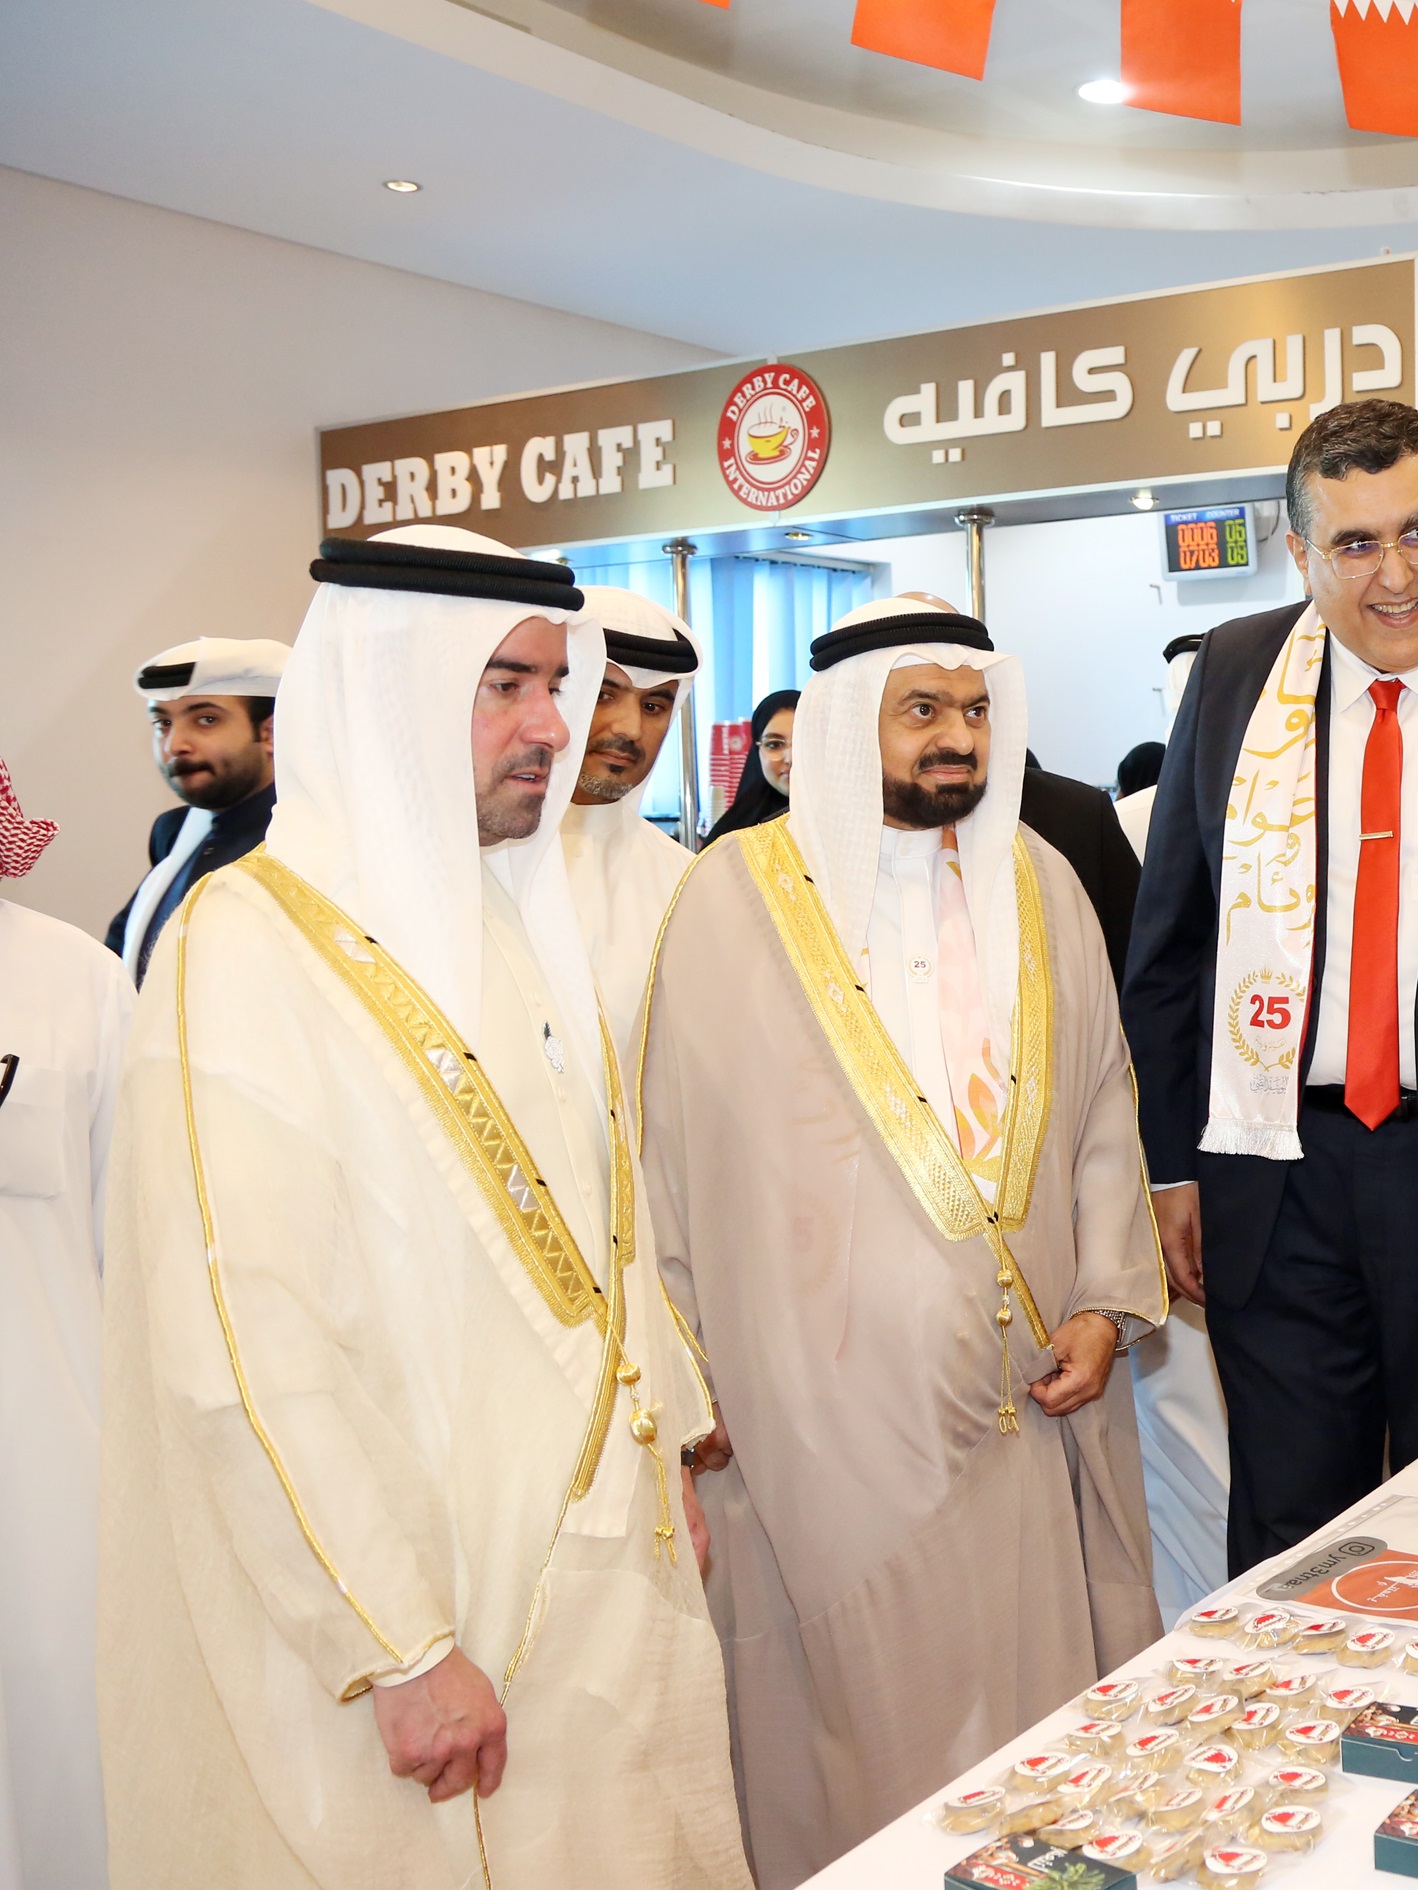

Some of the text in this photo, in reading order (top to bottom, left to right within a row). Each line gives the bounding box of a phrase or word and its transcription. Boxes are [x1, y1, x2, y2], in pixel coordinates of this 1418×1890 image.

[726, 372, 816, 422] DERBY CAFE
[883, 323, 1403, 465] دربي كافيه
[325, 419, 675, 530] DERBY CAFE
[723, 448, 821, 507] INTERNATIONAL
[1170, 508, 1240, 521] TICKET COUNTER
[1177, 519, 1246, 546] 0006 05
[1179, 544, 1220, 570] 0703
[914, 960, 927, 968] 25
[1249, 993, 1292, 1030] 25
